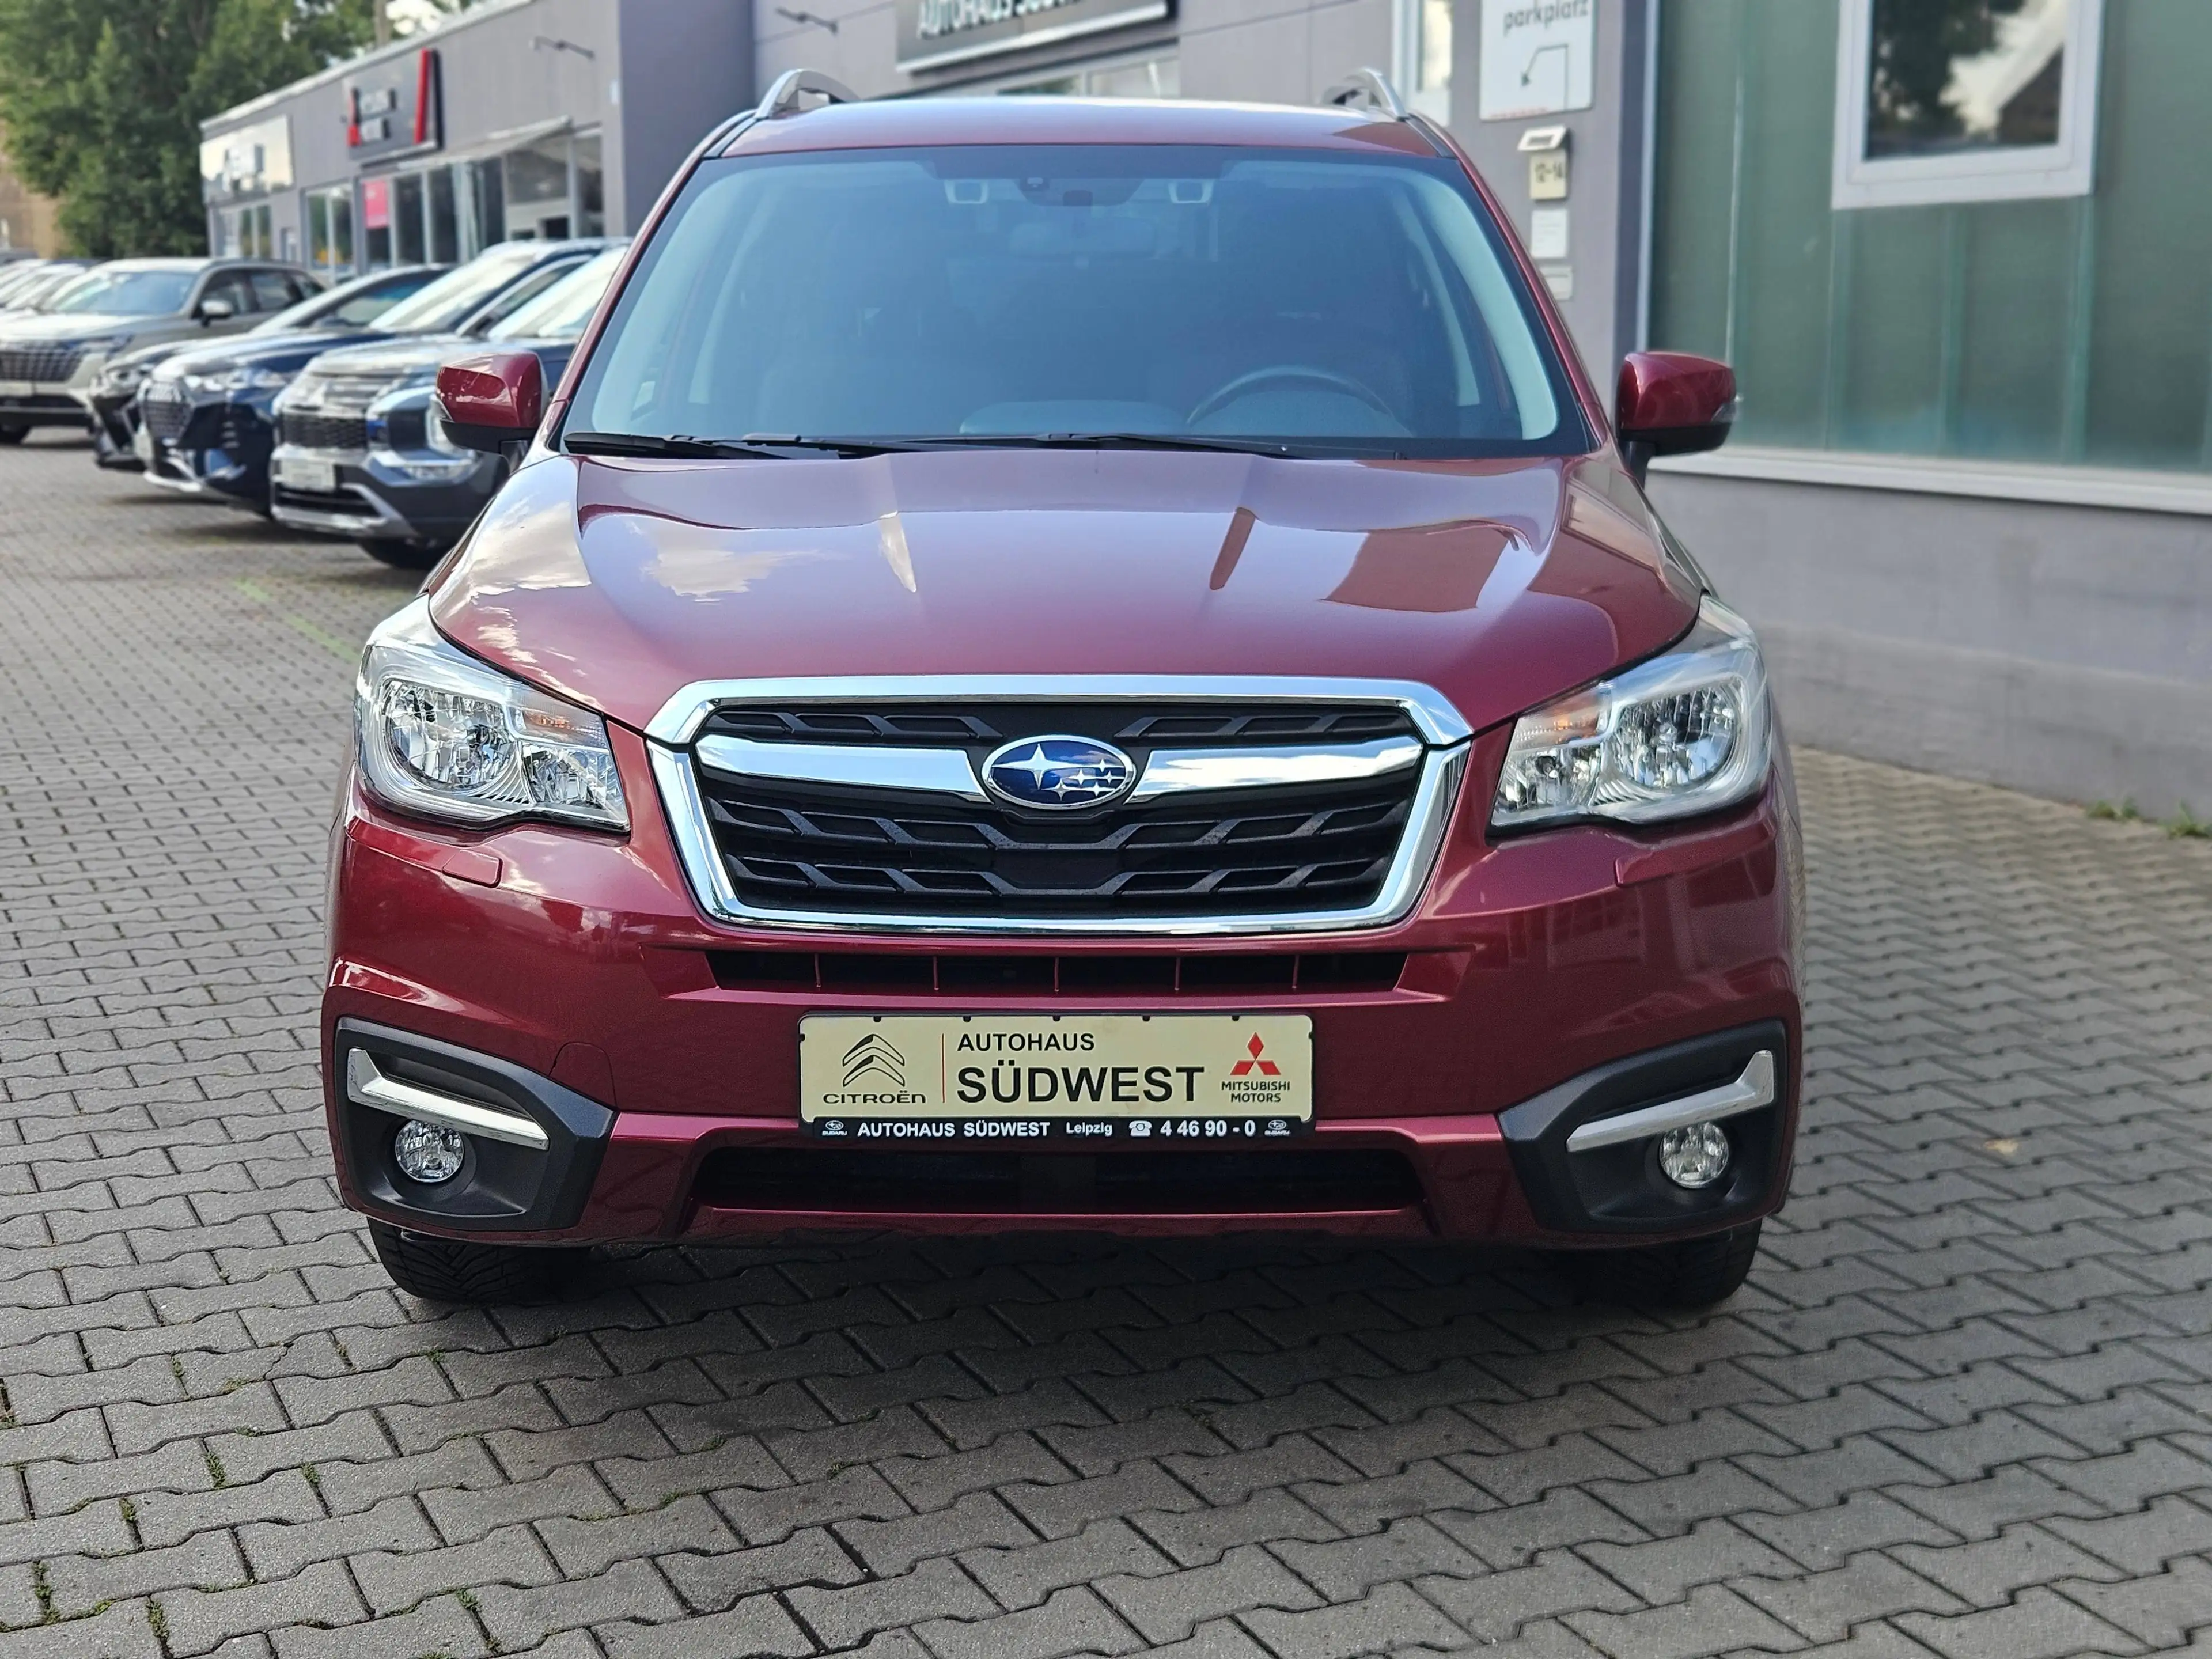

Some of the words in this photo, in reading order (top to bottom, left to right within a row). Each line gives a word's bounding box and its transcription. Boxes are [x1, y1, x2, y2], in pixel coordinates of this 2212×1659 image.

[1503, 0, 1589, 37] parkplatz
[957, 1033, 1095, 1051] AUTOHAUS
[957, 1059, 1205, 1104] SÜDWEST
[1221, 1081, 1290, 1091] MITSUBISHI
[1230, 1093, 1281, 1103] MOTORS
[857, 1122, 956, 1138] AUTOHAUS
[963, 1120, 1051, 1137] SÜDWEST
[1066, 1121, 1113, 1137] Leipzig
